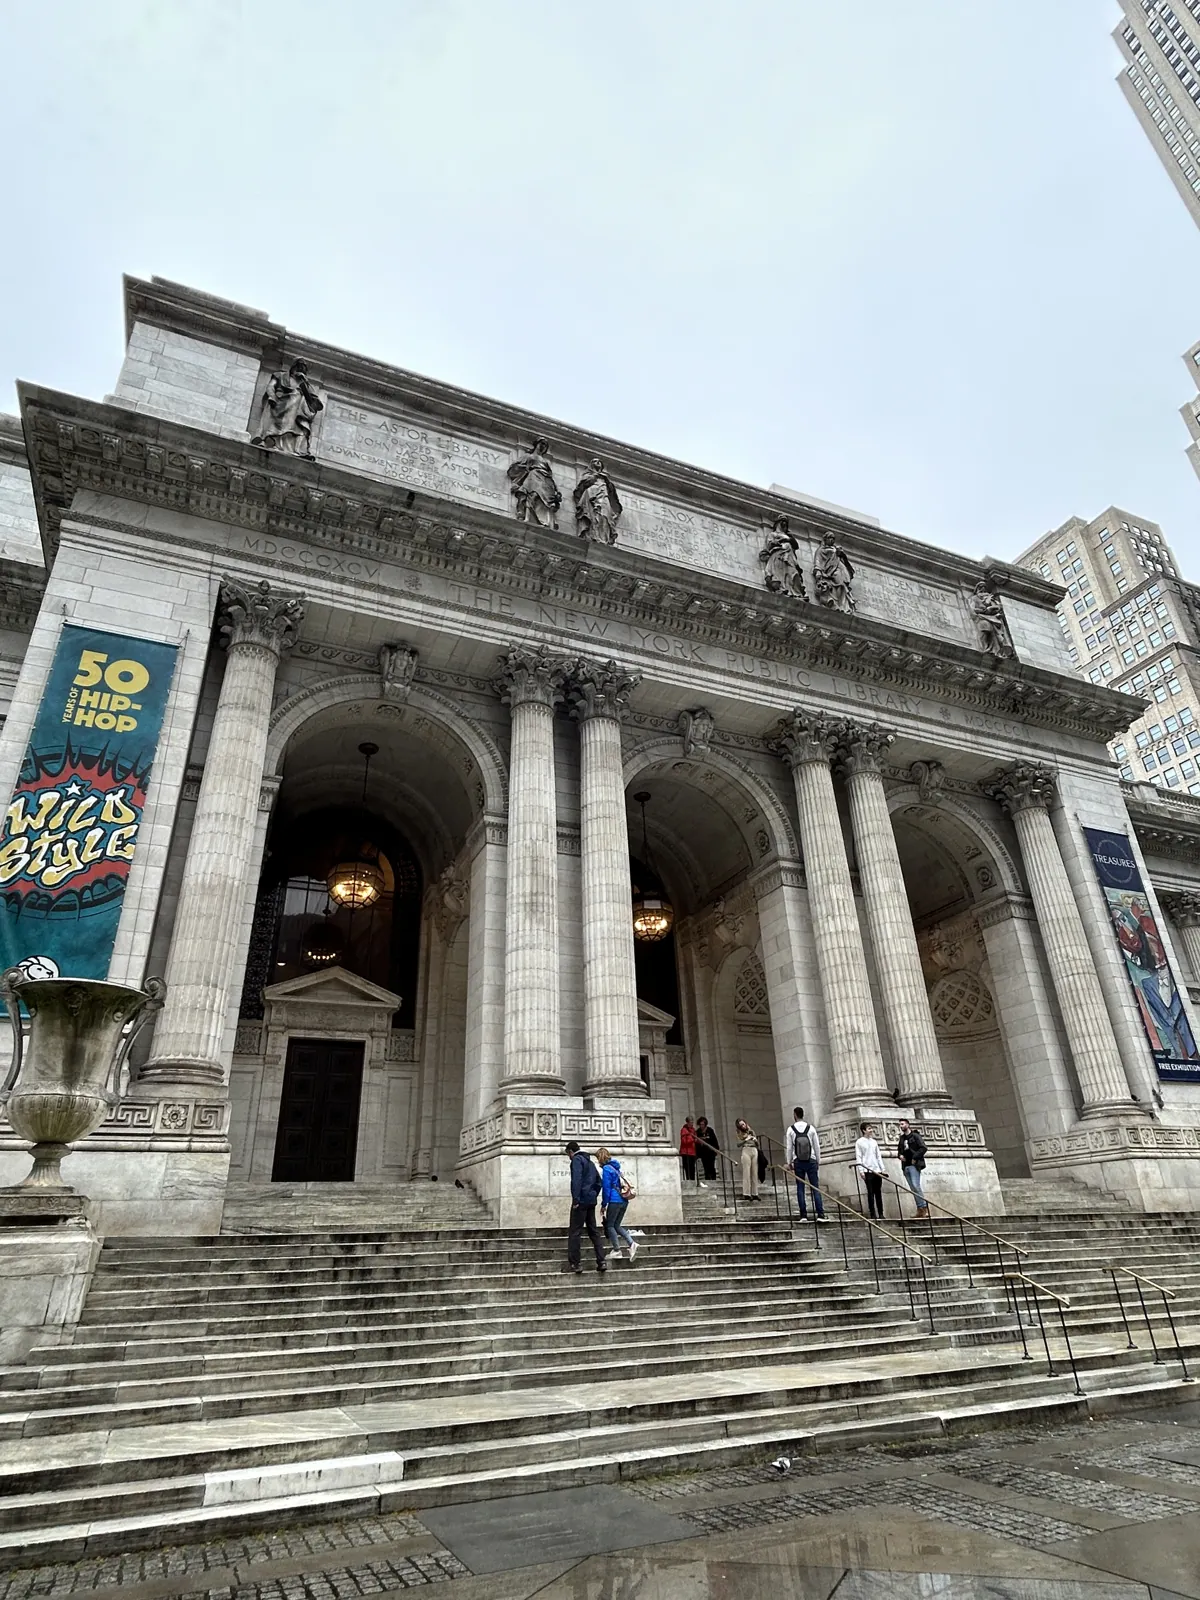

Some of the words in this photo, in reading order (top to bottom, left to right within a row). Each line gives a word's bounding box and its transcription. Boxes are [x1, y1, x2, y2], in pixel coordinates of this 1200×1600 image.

[337, 407, 368, 424] THE
[379, 421, 429, 443] ASTOR
[437, 437, 501, 464] LIBRARY
[356, 435, 391, 451] JOHN
[396, 448, 436, 464] JACOB
[443, 461, 479, 477] ASTOR
[396, 456, 415, 466] FOR
[421, 463, 439, 473] THE
[328, 445, 398, 471] ADVANCEMENT
[402, 465, 414, 474] OF
[418, 470, 449, 484] USEFUL
[451, 481, 502, 499] KNOWLEDGE
[622, 494, 646, 510] THE
[652, 503, 695, 525] LENOX
[700, 519, 750, 543] LIBRARY
[621, 530, 672, 550] LITERATURE
[640, 528, 684, 545] DEDICATED
[653, 525, 685, 539] JAMES
[693, 537, 726, 552] LENOX
[877, 574, 913, 592] TILDEN
[919, 587, 951, 603] TRUST
[242, 535, 380, 579] MDCCCXCV
[448, 583, 515, 617] THE
[537, 605, 611, 637] NEW
[635, 629, 705, 662] YORK
[726, 652, 811, 687] PUBLIC
[832, 678, 922, 715] LIBRARY
[73, 650, 151, 695] 50
[62, 698, 76, 724] YEARS
[69, 687, 78, 699] OF
[80, 691, 142, 713] HIP-
[73, 711, 137, 733] HOP
[1093, 853, 1136, 869] TREASURES
